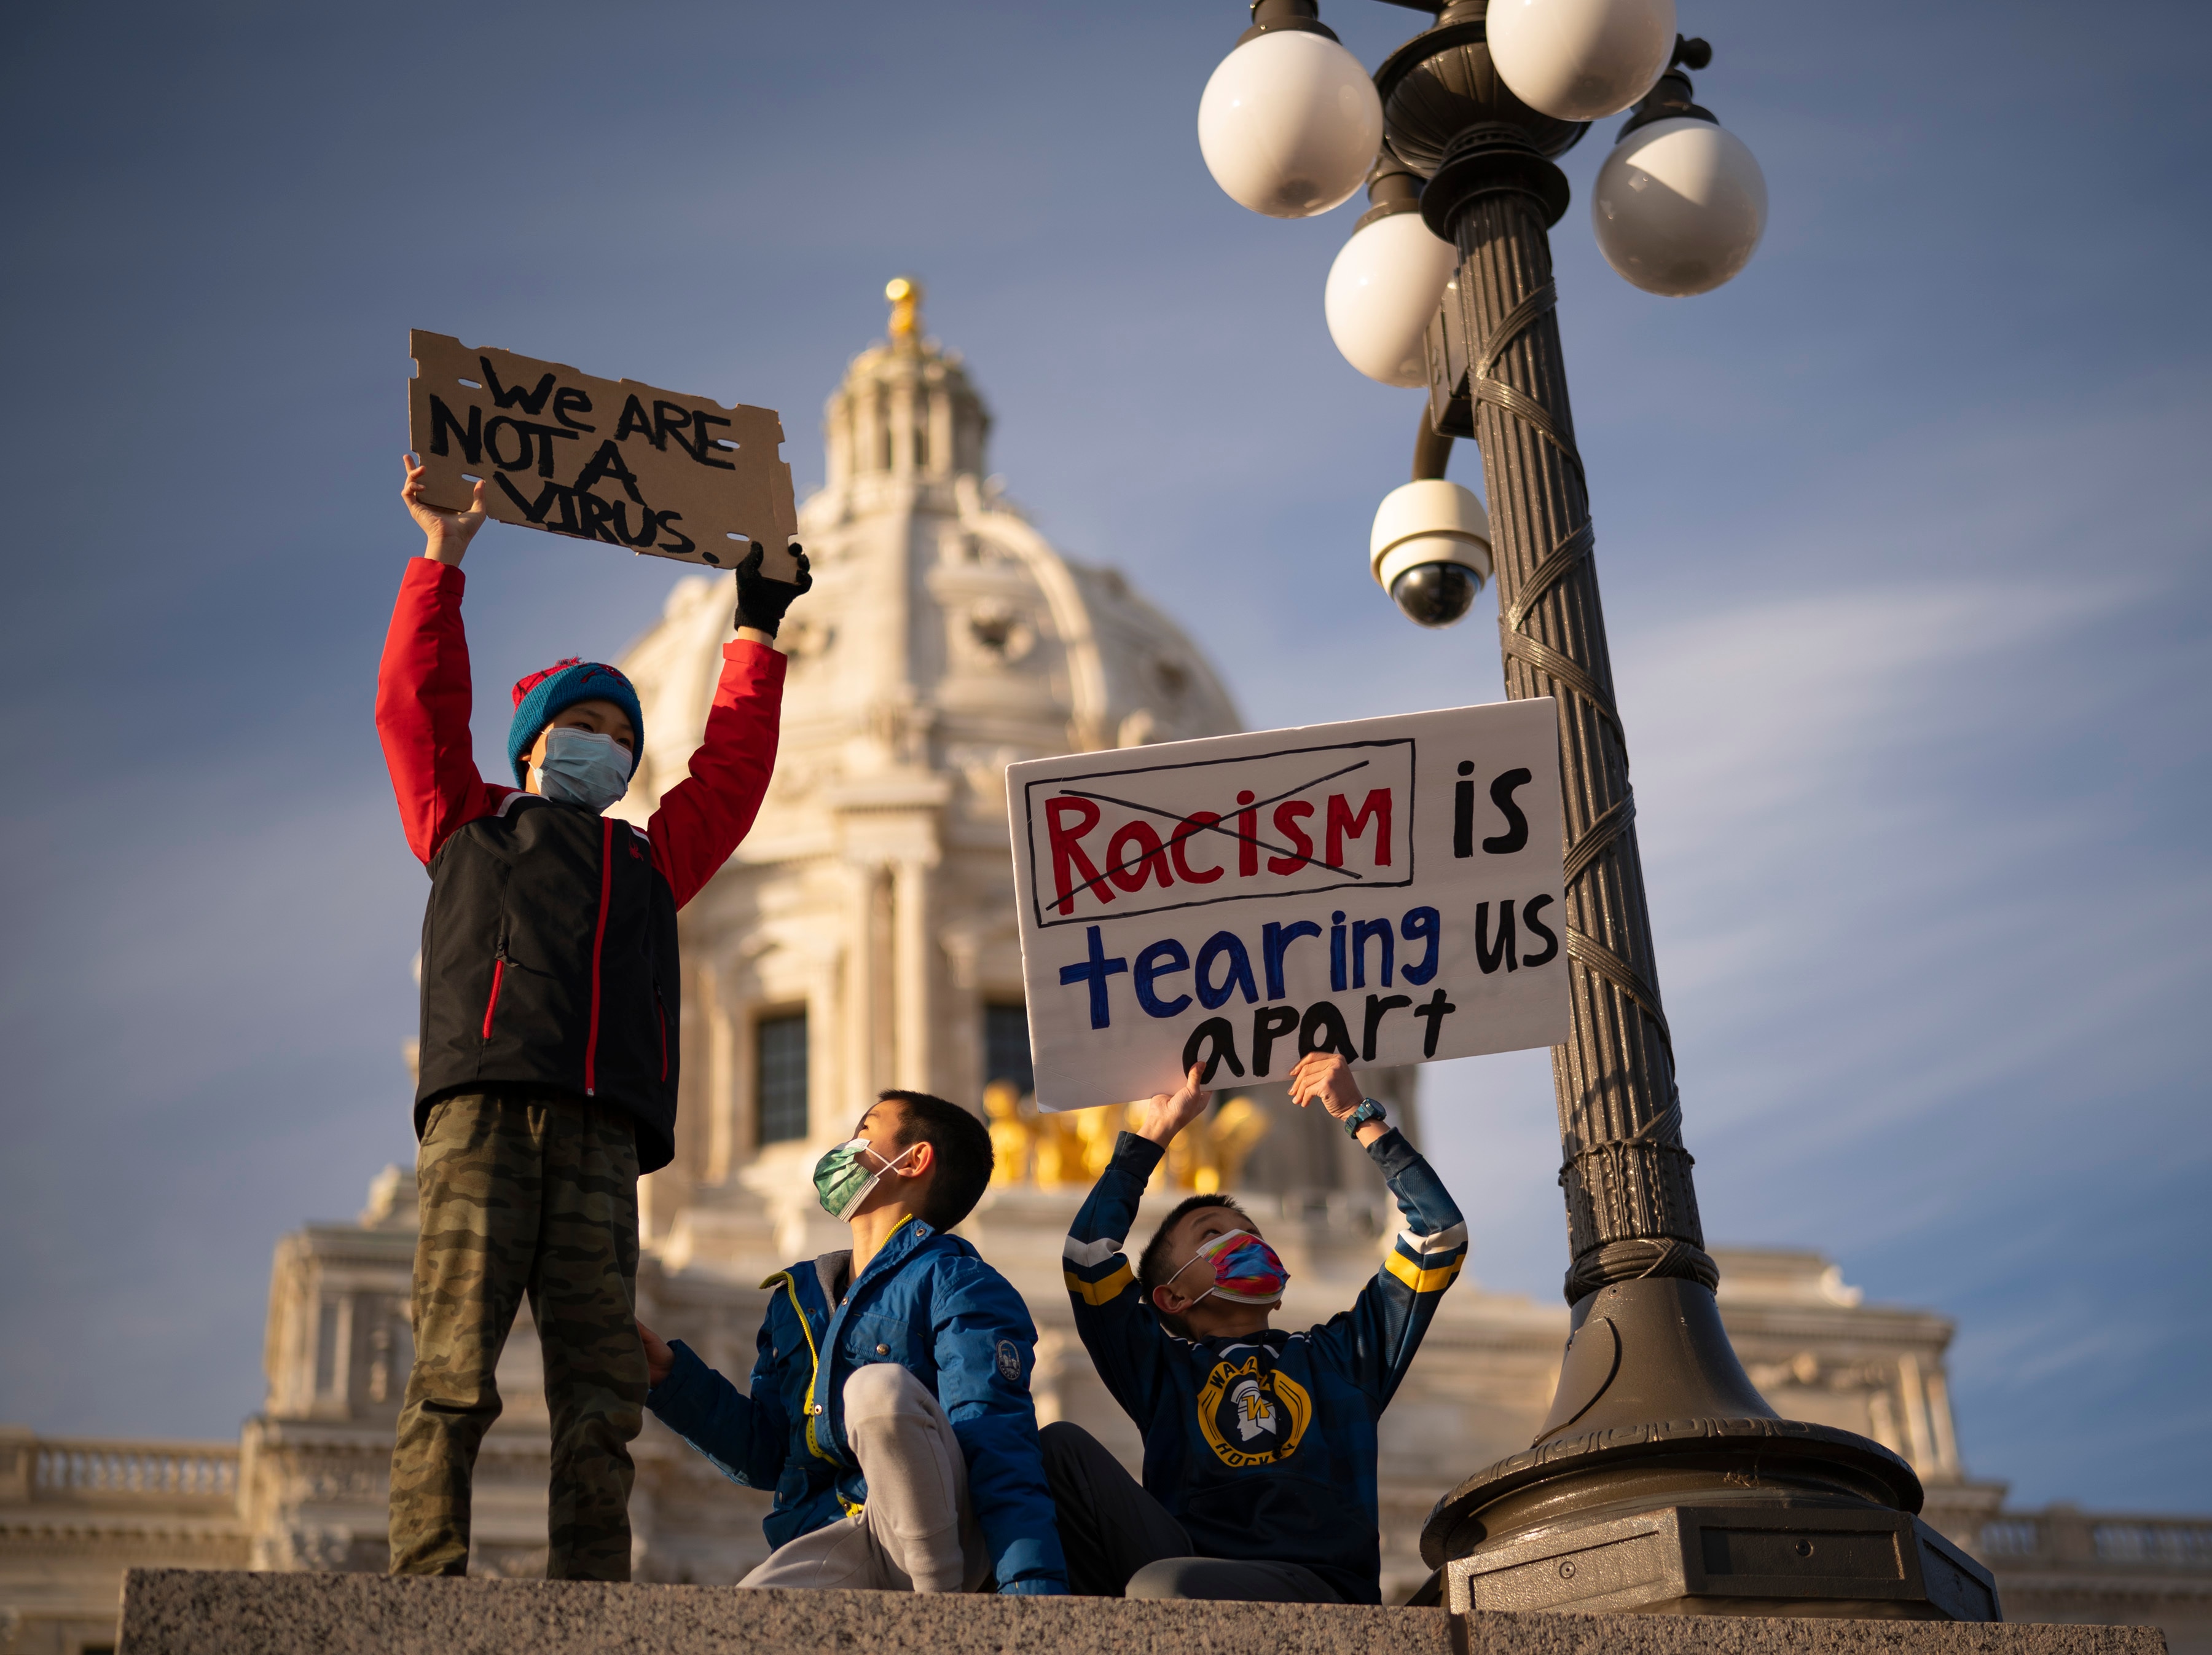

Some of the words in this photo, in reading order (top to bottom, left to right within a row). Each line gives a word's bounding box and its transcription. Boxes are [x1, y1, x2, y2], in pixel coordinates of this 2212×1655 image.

[429, 393, 579, 478] NOT
[574, 439, 647, 508] A
[479, 356, 596, 433] We
[615, 394, 735, 470] ARE
[493, 471, 720, 564] VIRUS.
[1453, 760, 1532, 859] is
[1059, 906, 1441, 1030] tearing
[1476, 894, 1559, 973] us
